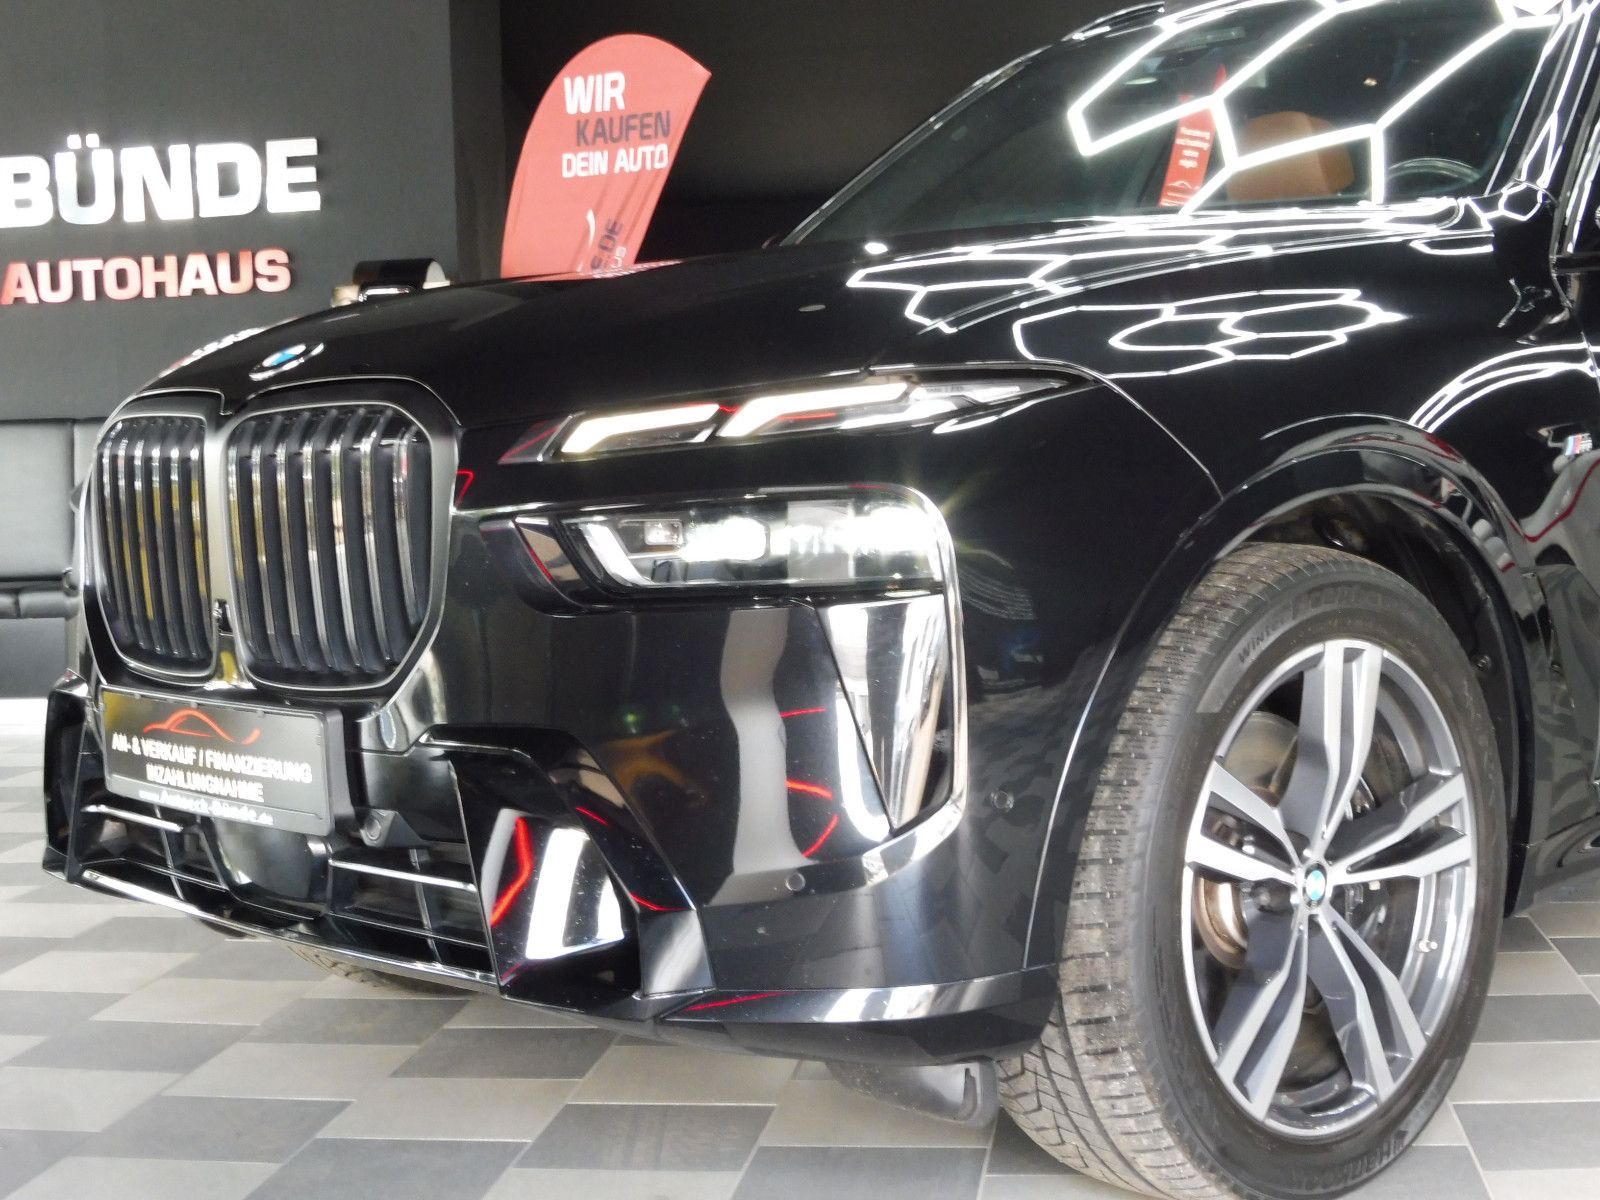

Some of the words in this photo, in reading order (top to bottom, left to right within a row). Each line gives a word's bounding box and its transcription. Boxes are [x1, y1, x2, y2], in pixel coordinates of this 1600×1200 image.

[563, 71, 626, 115] WIR
[576, 110, 671, 147] KAUFEN
[0, 133, 321, 228] BÜNDE
[561, 149, 608, 178] DEIN
[613, 143, 669, 174] AUTO
[0, 248, 292, 305] AUTOHAUS
[141, 736, 197, 765] VERKAUF
[205, 747, 313, 784] FINANZIERUNG
